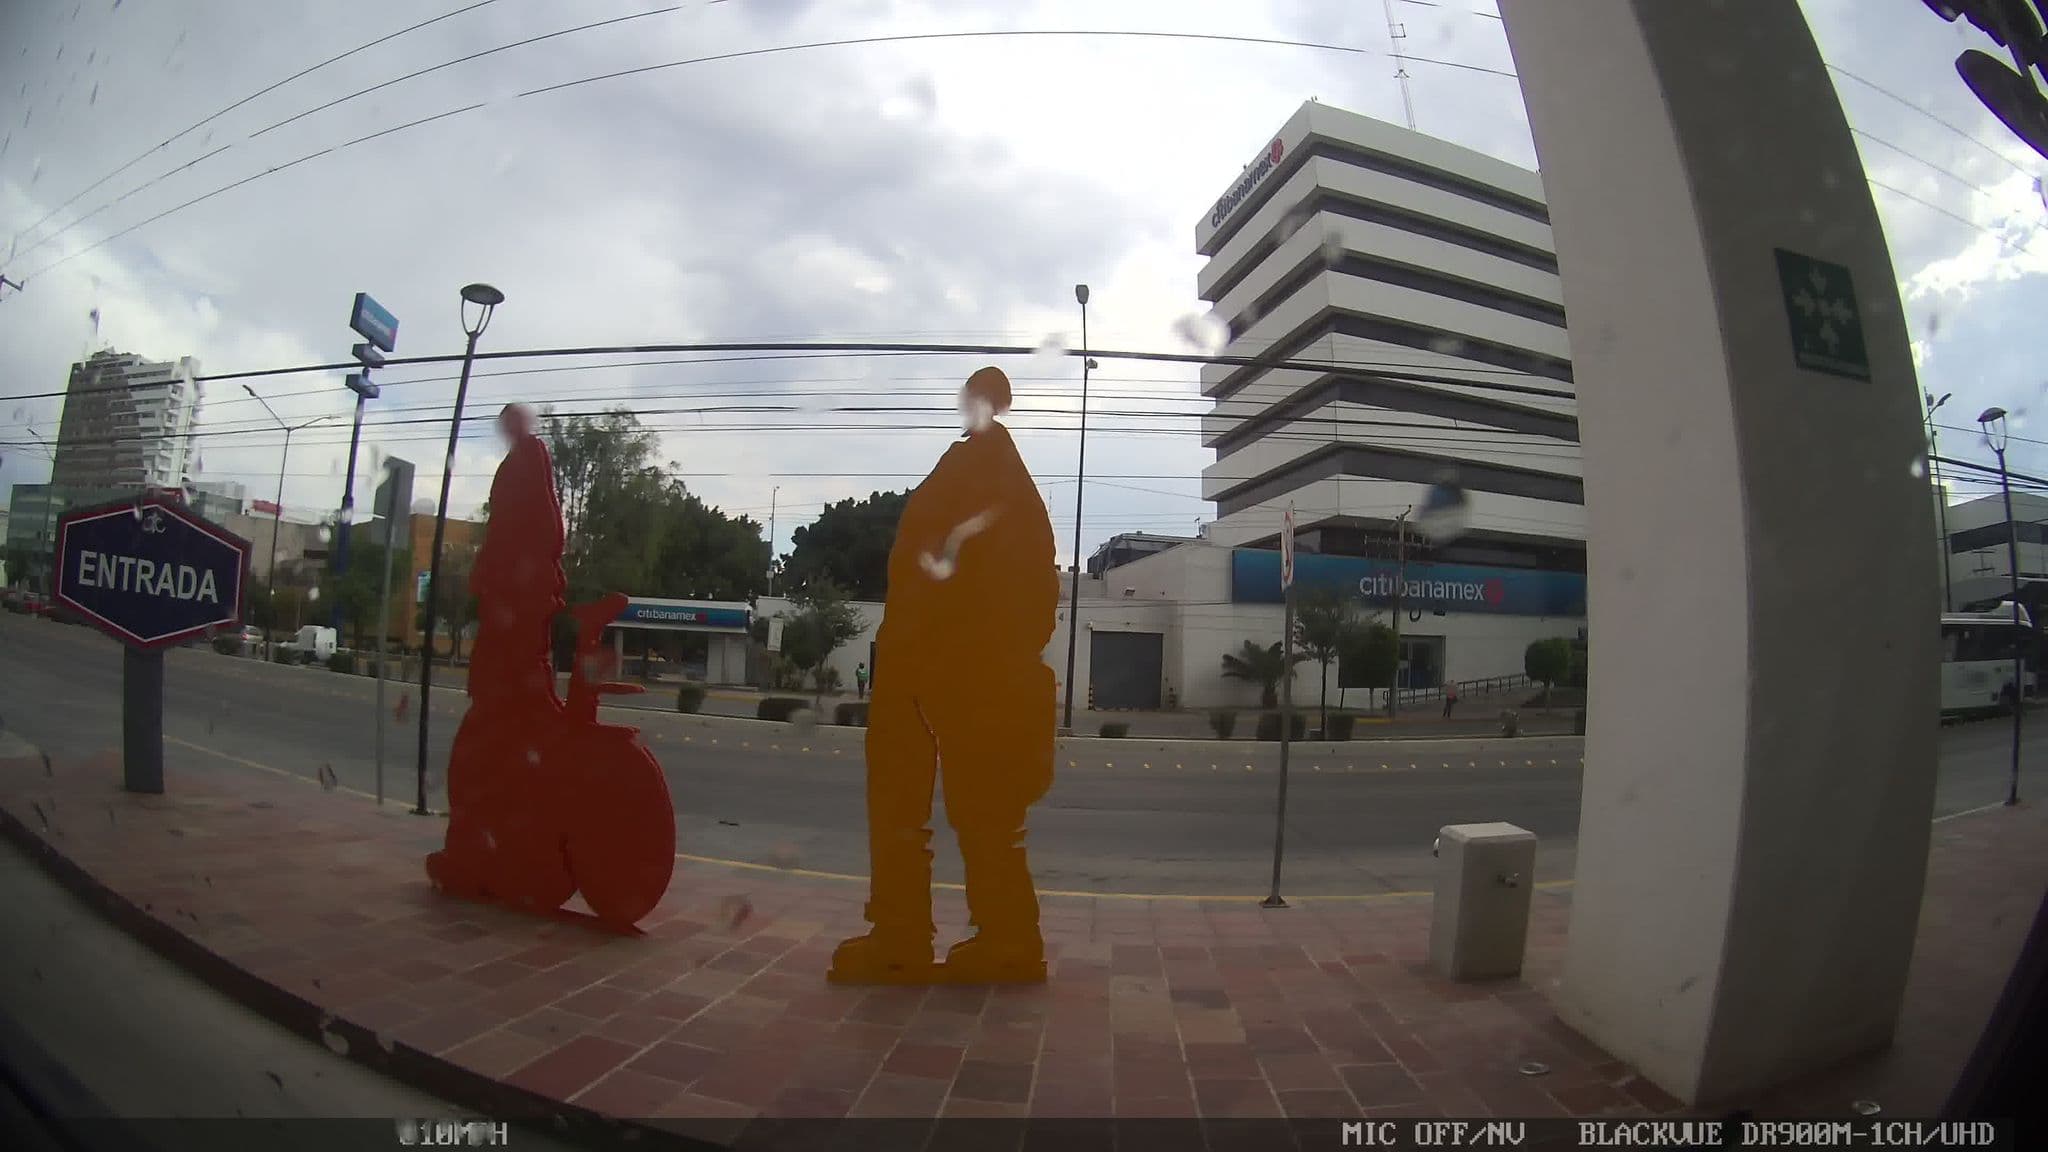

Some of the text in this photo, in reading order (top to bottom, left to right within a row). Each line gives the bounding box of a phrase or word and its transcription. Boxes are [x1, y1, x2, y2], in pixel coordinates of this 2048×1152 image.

[1211, 151, 1273, 228] citibanamex
[78, 549, 218, 604] ENTRADA
[1359, 572, 1485, 601] citibanamex
[637, 608, 697, 622] citibanamex
